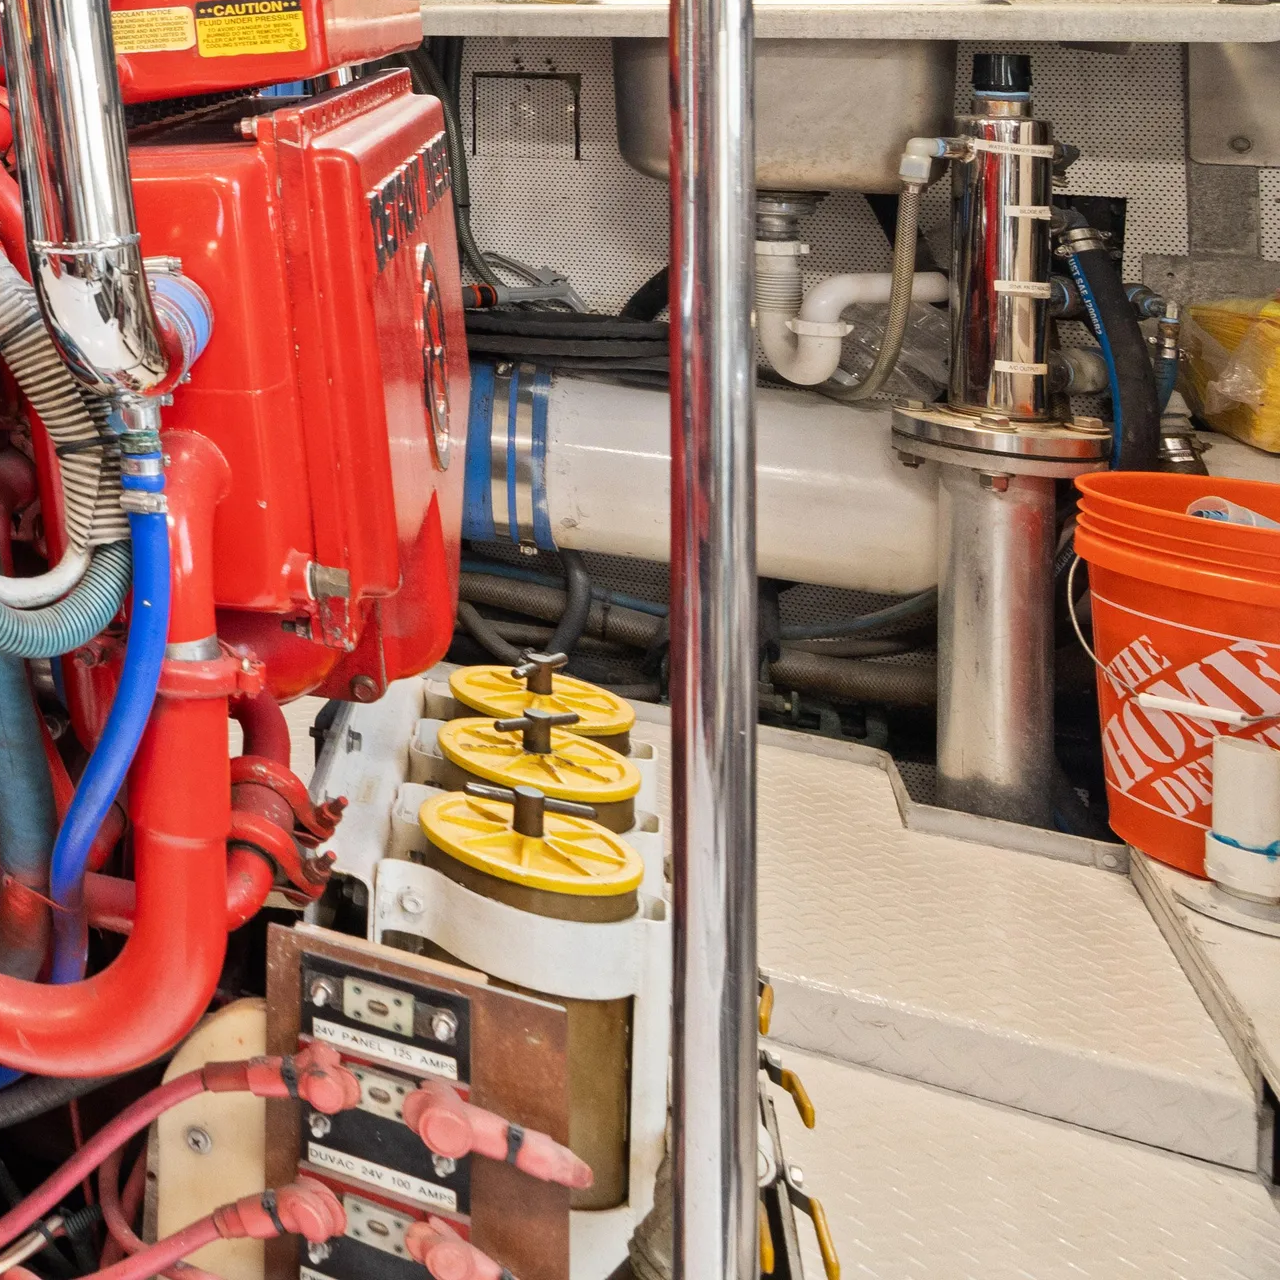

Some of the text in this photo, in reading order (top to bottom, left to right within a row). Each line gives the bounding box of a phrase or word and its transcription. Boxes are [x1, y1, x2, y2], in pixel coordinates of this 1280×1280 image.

[112, 10, 144, 18] COOLANT
[198, 13, 300, 26] FLUID UNDER PRESSURE
[988, 144, 1009, 152] WATER
[1104, 634, 1172, 700] THE
[1103, 640, 1280, 792] HOME
[314, 1024, 457, 1074] 24V PANEL 125 AMPS
[310, 1147, 455, 1206] DUVAC 24V 100 AMPS
